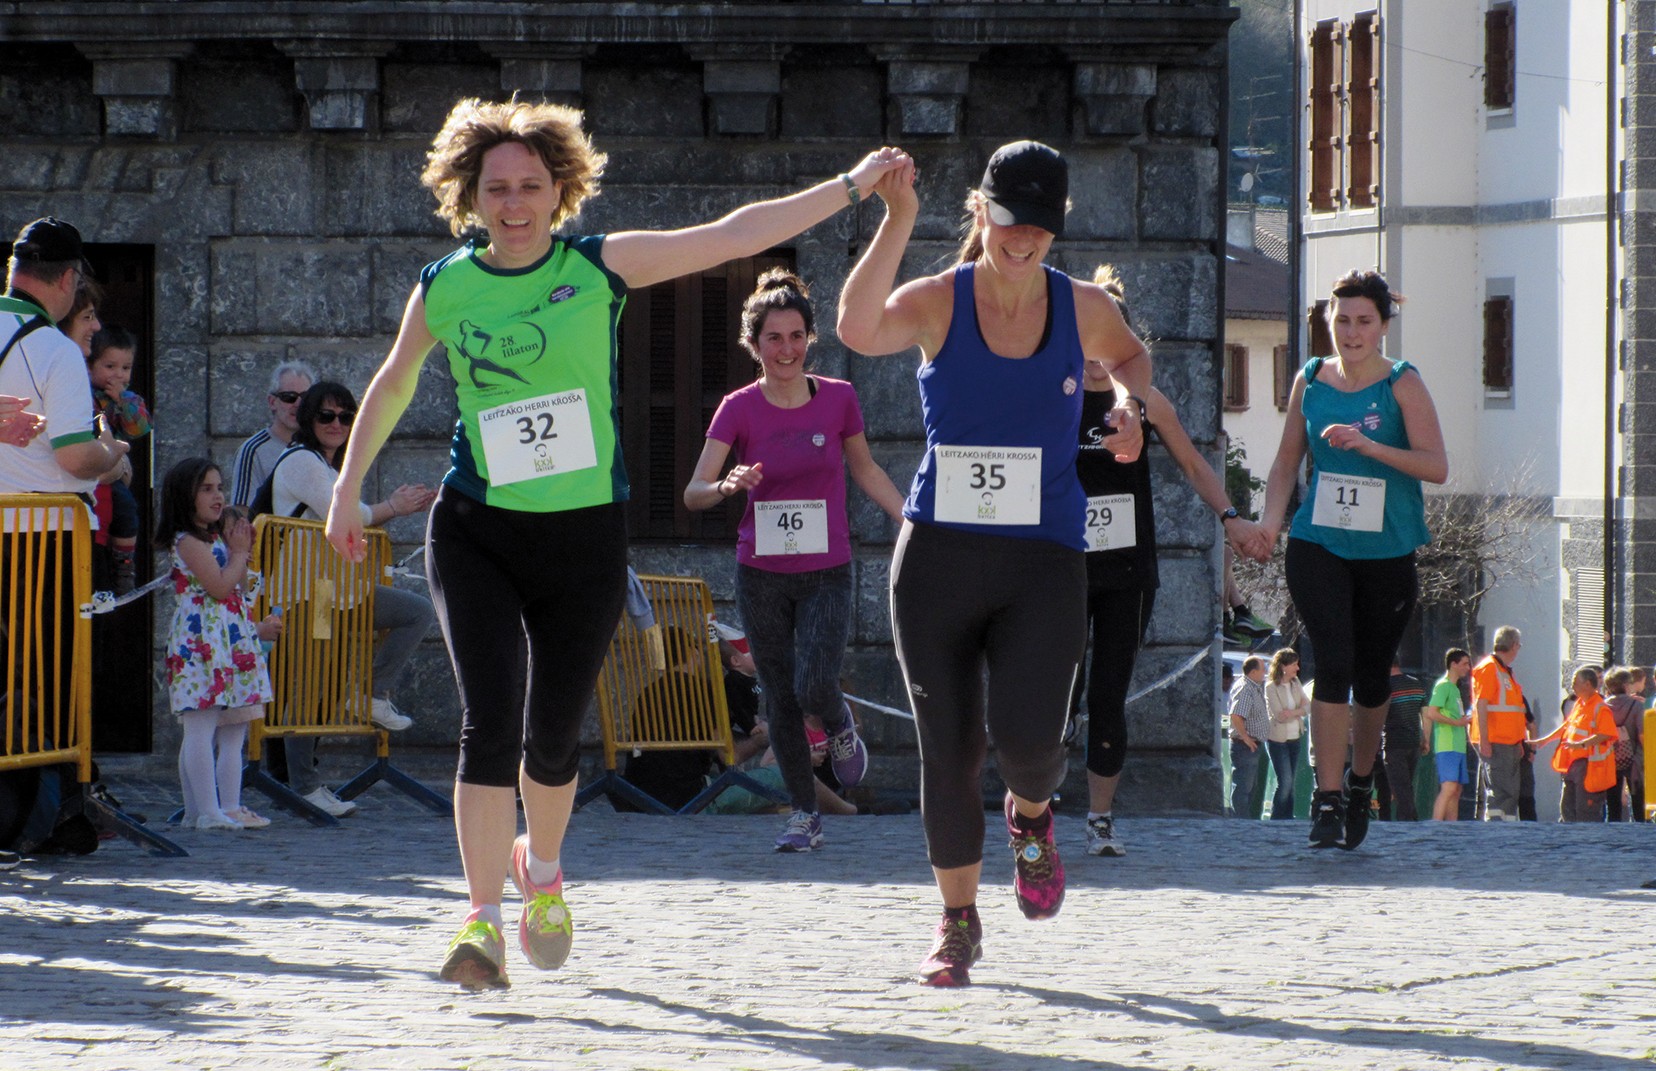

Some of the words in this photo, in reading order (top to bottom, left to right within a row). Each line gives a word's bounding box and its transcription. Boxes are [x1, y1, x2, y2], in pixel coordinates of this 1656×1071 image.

[502, 341, 539, 359] lilaton
[483, 405, 523, 422] LEITZAKO
[524, 400, 550, 412] HERRI
[551, 394, 583, 407] KROSSA
[516, 412, 558, 445] 32
[940, 450, 979, 459] LEITZAKO
[980, 451, 1005, 460] HERRI
[1006, 452, 1037, 460] KROSSA
[970, 463, 1006, 490] 35
[1336, 486, 1360, 506] 11
[777, 512, 804, 531] 46
[1086, 507, 1113, 528] 29
